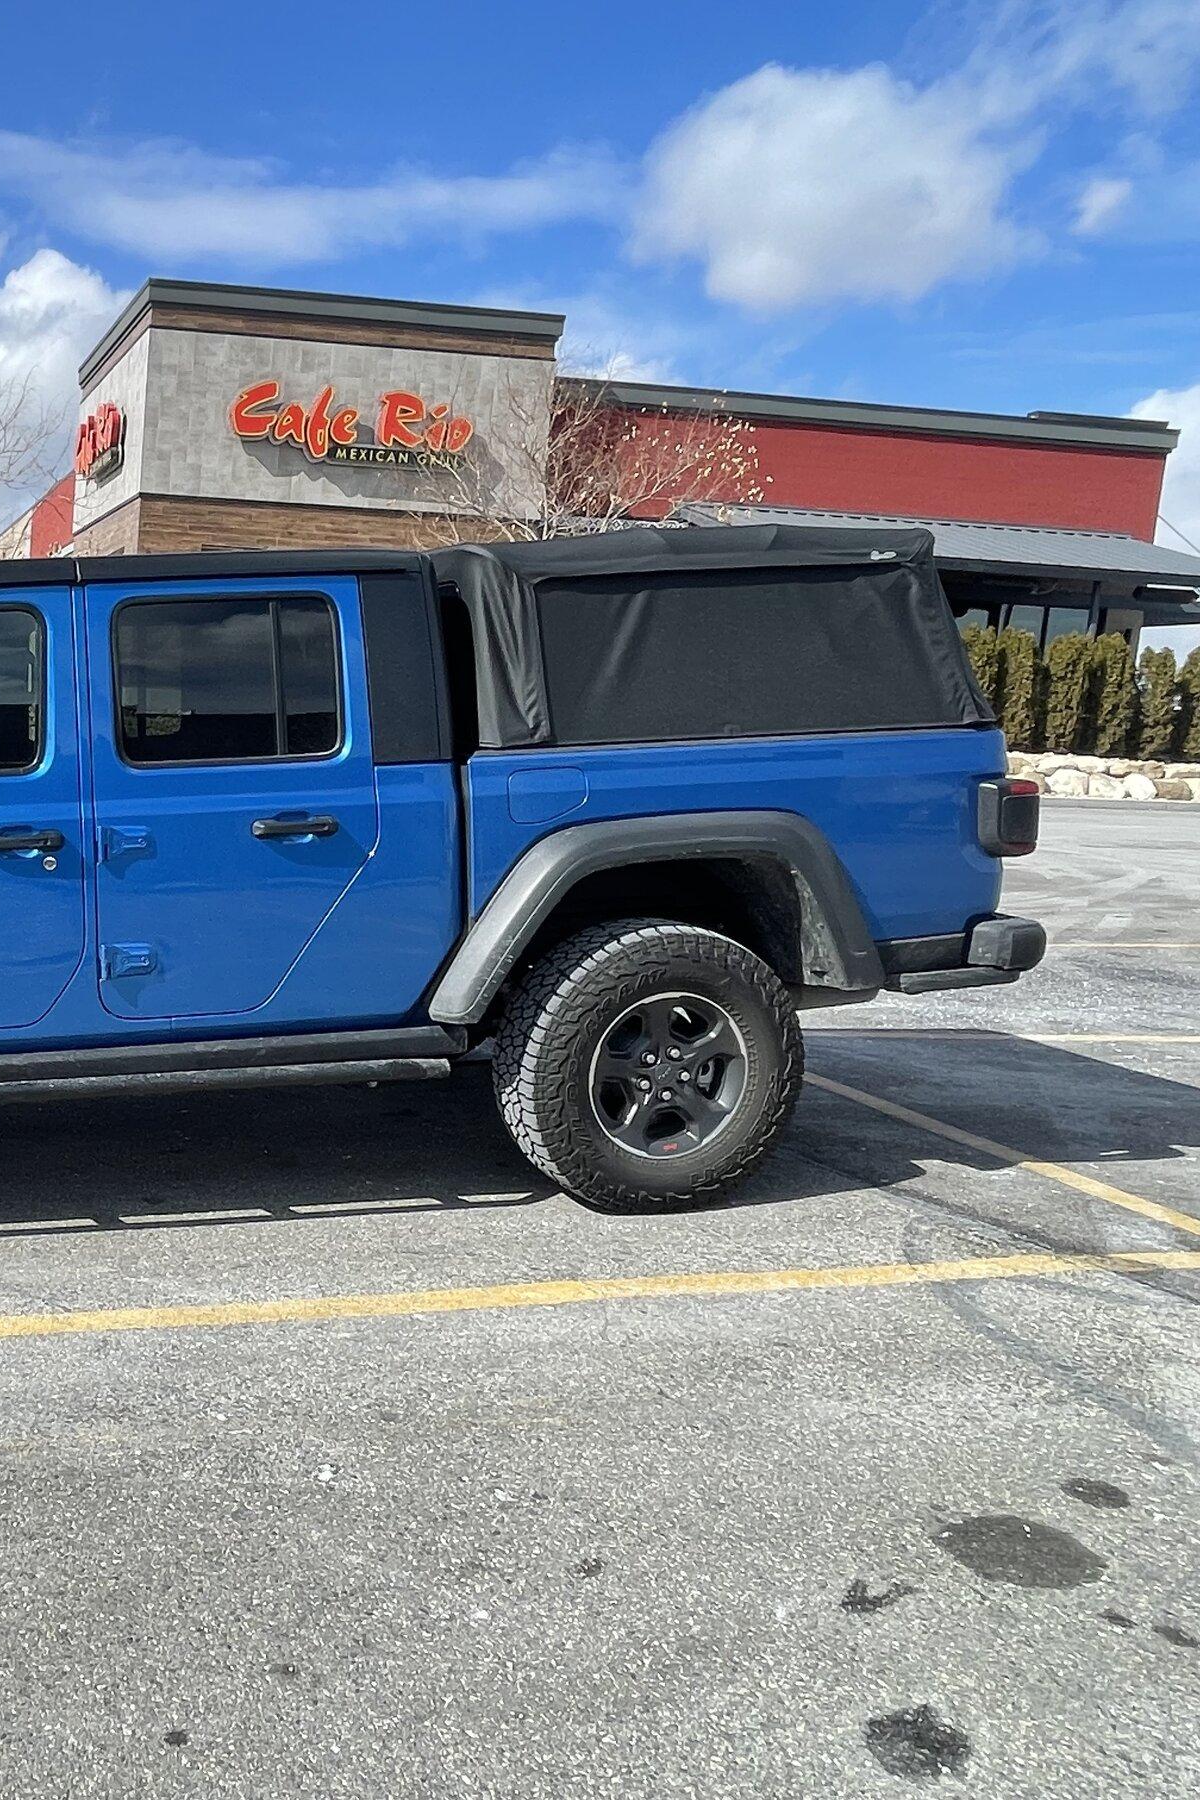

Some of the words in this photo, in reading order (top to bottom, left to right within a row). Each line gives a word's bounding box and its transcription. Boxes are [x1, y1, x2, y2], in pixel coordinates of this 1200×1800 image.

[231, 380, 358, 459] Cafe
[377, 390, 474, 453] Rio
[335, 448, 409, 464] MEXICAN
